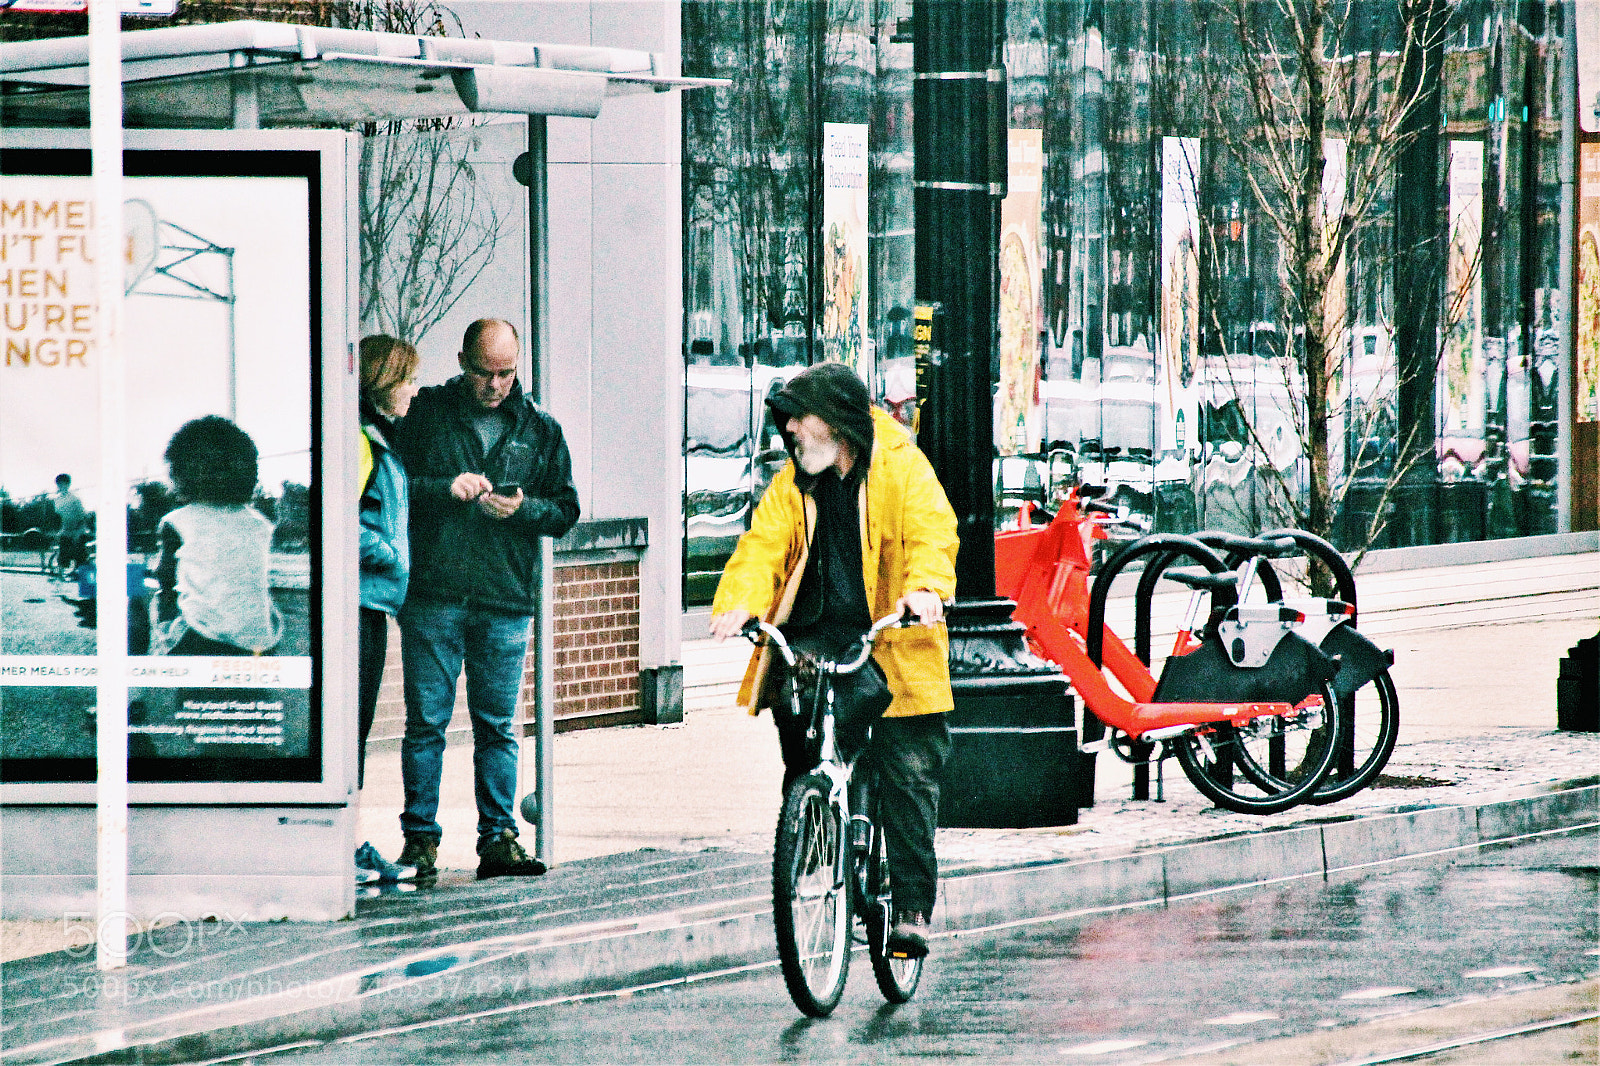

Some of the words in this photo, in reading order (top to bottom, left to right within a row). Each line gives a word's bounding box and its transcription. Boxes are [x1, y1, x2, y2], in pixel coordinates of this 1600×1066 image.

[211, 660, 280, 671] FEEDING
[30, 666, 71, 676] MEALS
[74, 667, 98, 677] FOR
[211, 673, 281, 684] AMERICA
